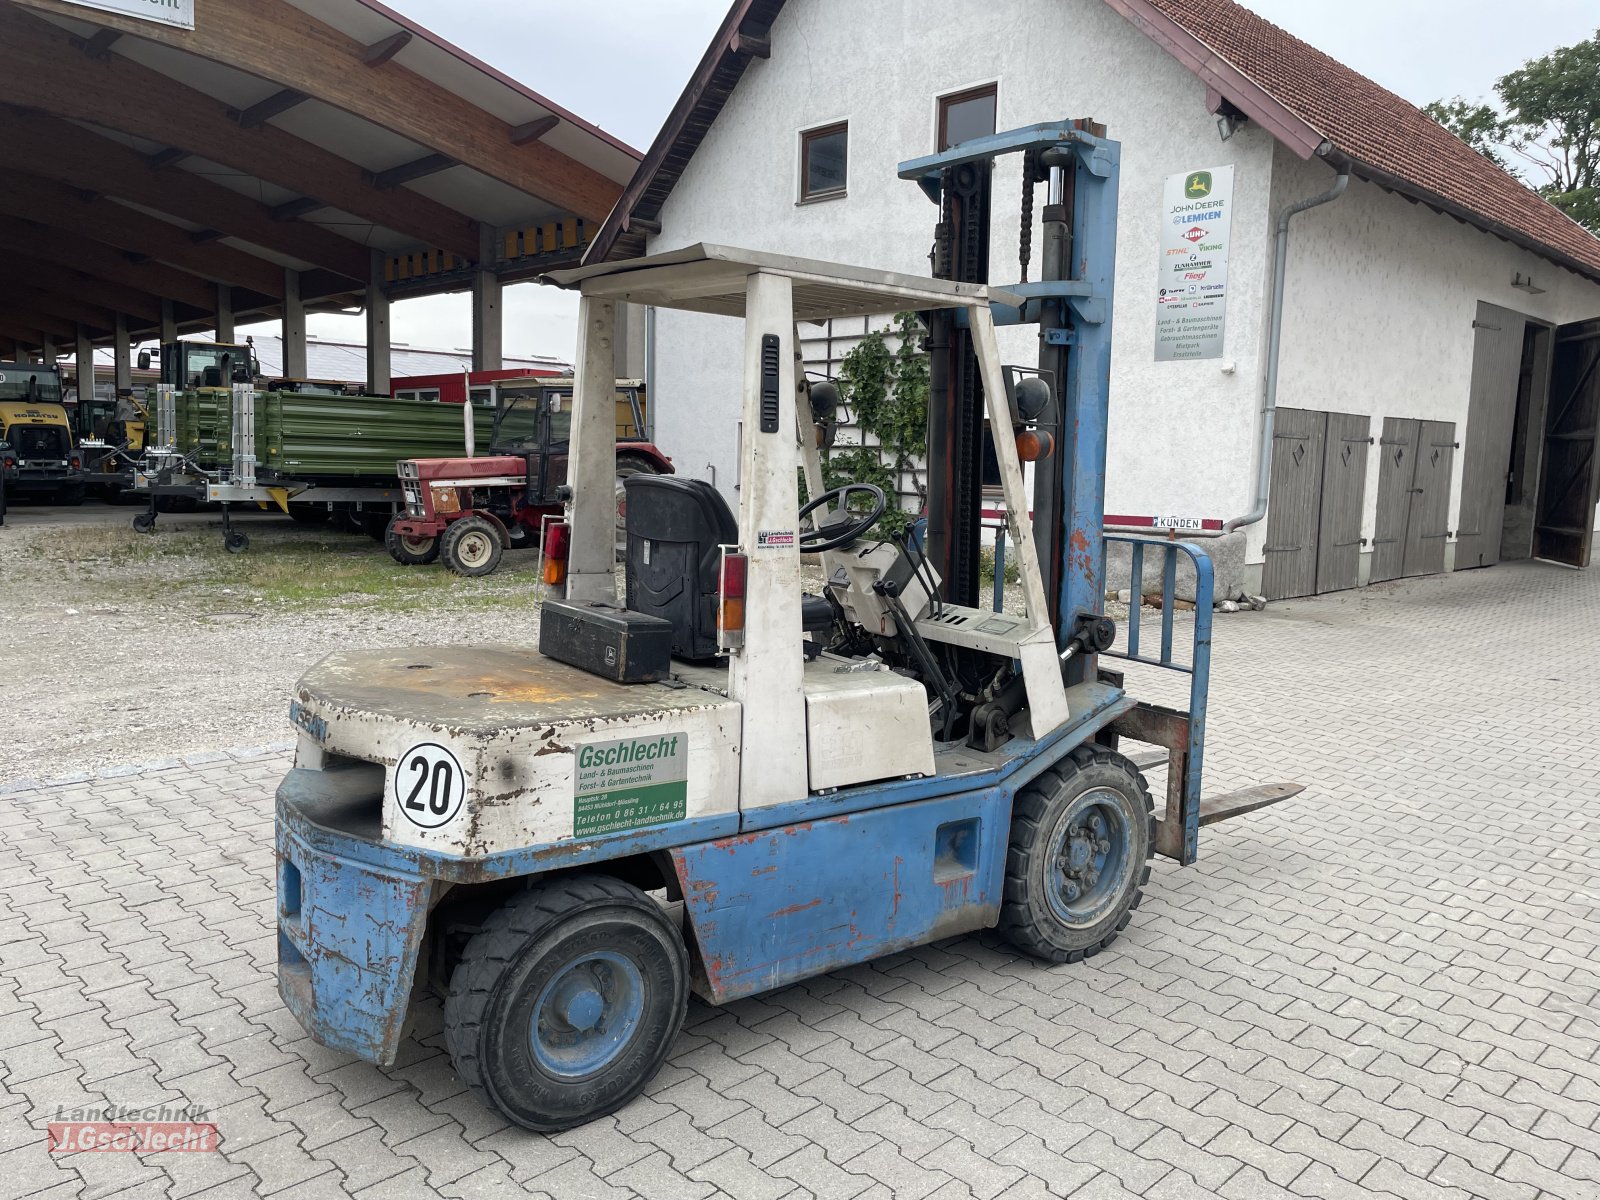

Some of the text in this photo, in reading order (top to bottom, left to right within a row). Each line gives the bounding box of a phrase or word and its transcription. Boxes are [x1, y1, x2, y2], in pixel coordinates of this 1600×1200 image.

[1170, 200, 1225, 214] JOHN DEERE
[1182, 211, 1222, 223] LEMKEN
[1184, 230, 1206, 239] KUHN
[1166, 247, 1189, 256] STIHL
[1198, 243, 1223, 252] VIKING
[1182, 315, 1223, 323] Baumaschinen
[1160, 518, 1200, 528] KUNDEN
[579, 736, 678, 769] Gschlecht
[579, 763, 654, 780] Land- & Baumaschinen
[405, 756, 453, 816] 20
[579, 773, 653, 791] Forst- & Gartentechnik
[577, 812, 612, 825] Telefon
[615, 811, 621, 819] 0
[624, 808, 636, 817] 86
[638, 806, 648, 815] 31
[660, 802, 670, 811] 64
[673, 800, 684, 809] 95
[576, 811, 684, 836] www.gschlecht-landtechnik.de
